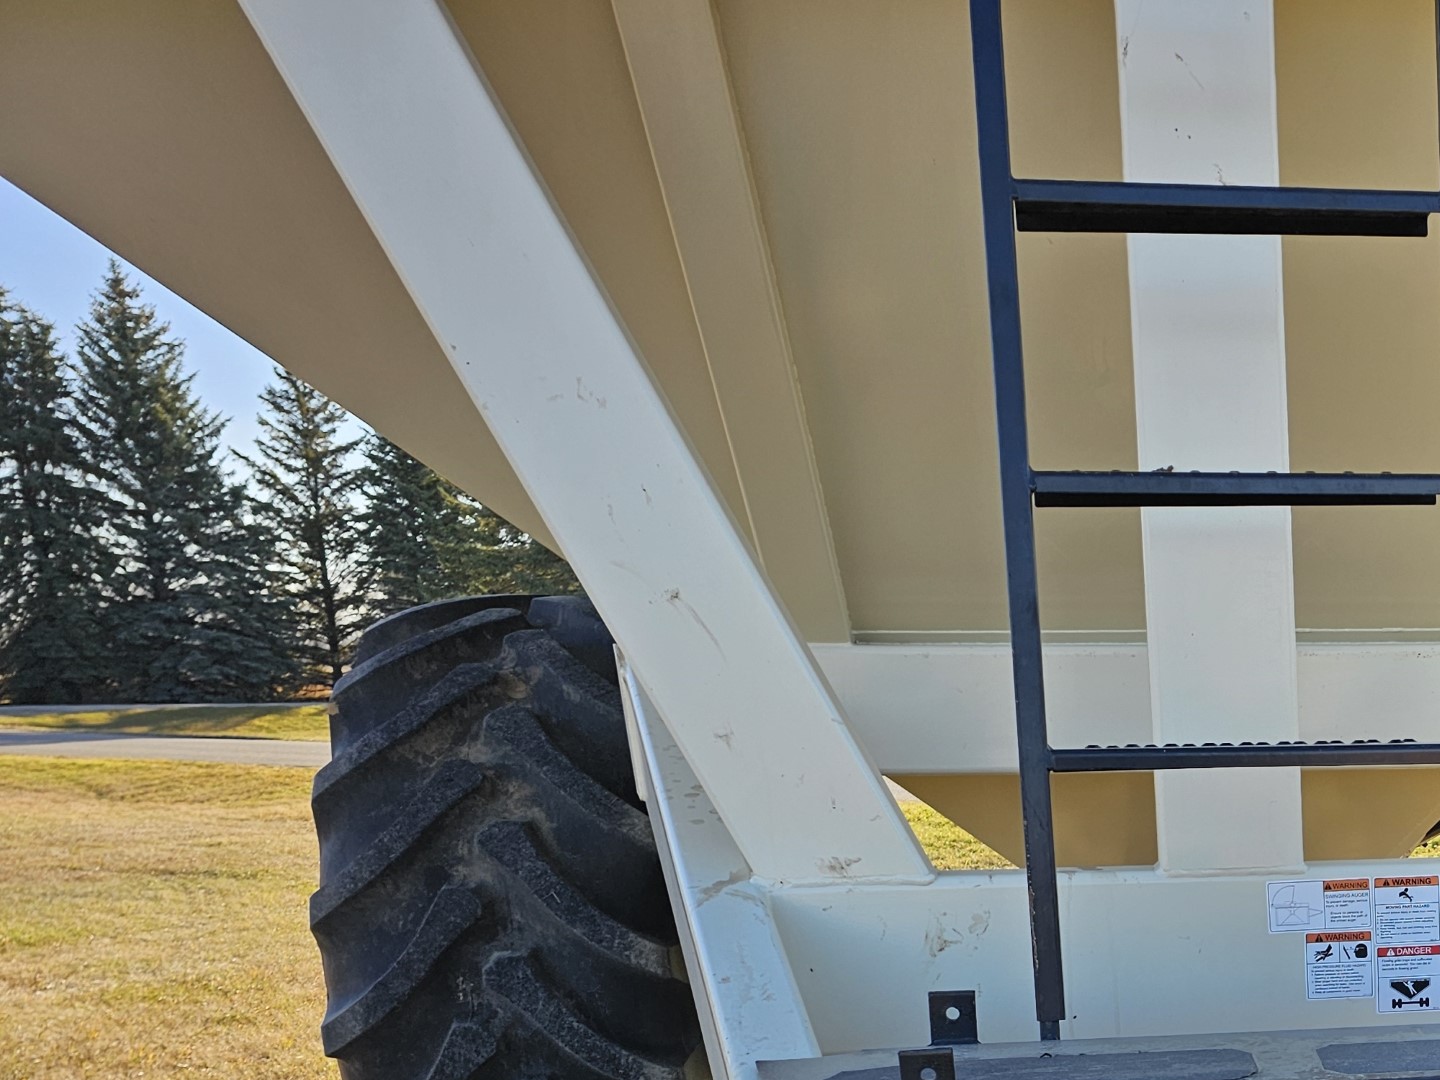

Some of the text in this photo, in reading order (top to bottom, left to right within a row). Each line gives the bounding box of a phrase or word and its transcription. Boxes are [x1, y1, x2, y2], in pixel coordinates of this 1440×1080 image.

[1333, 881, 1368, 889] WARNING
[1391, 877, 1432, 886] WARNING
[1324, 932, 1365, 941] WARNING
[1396, 947, 1432, 955] DANGER
